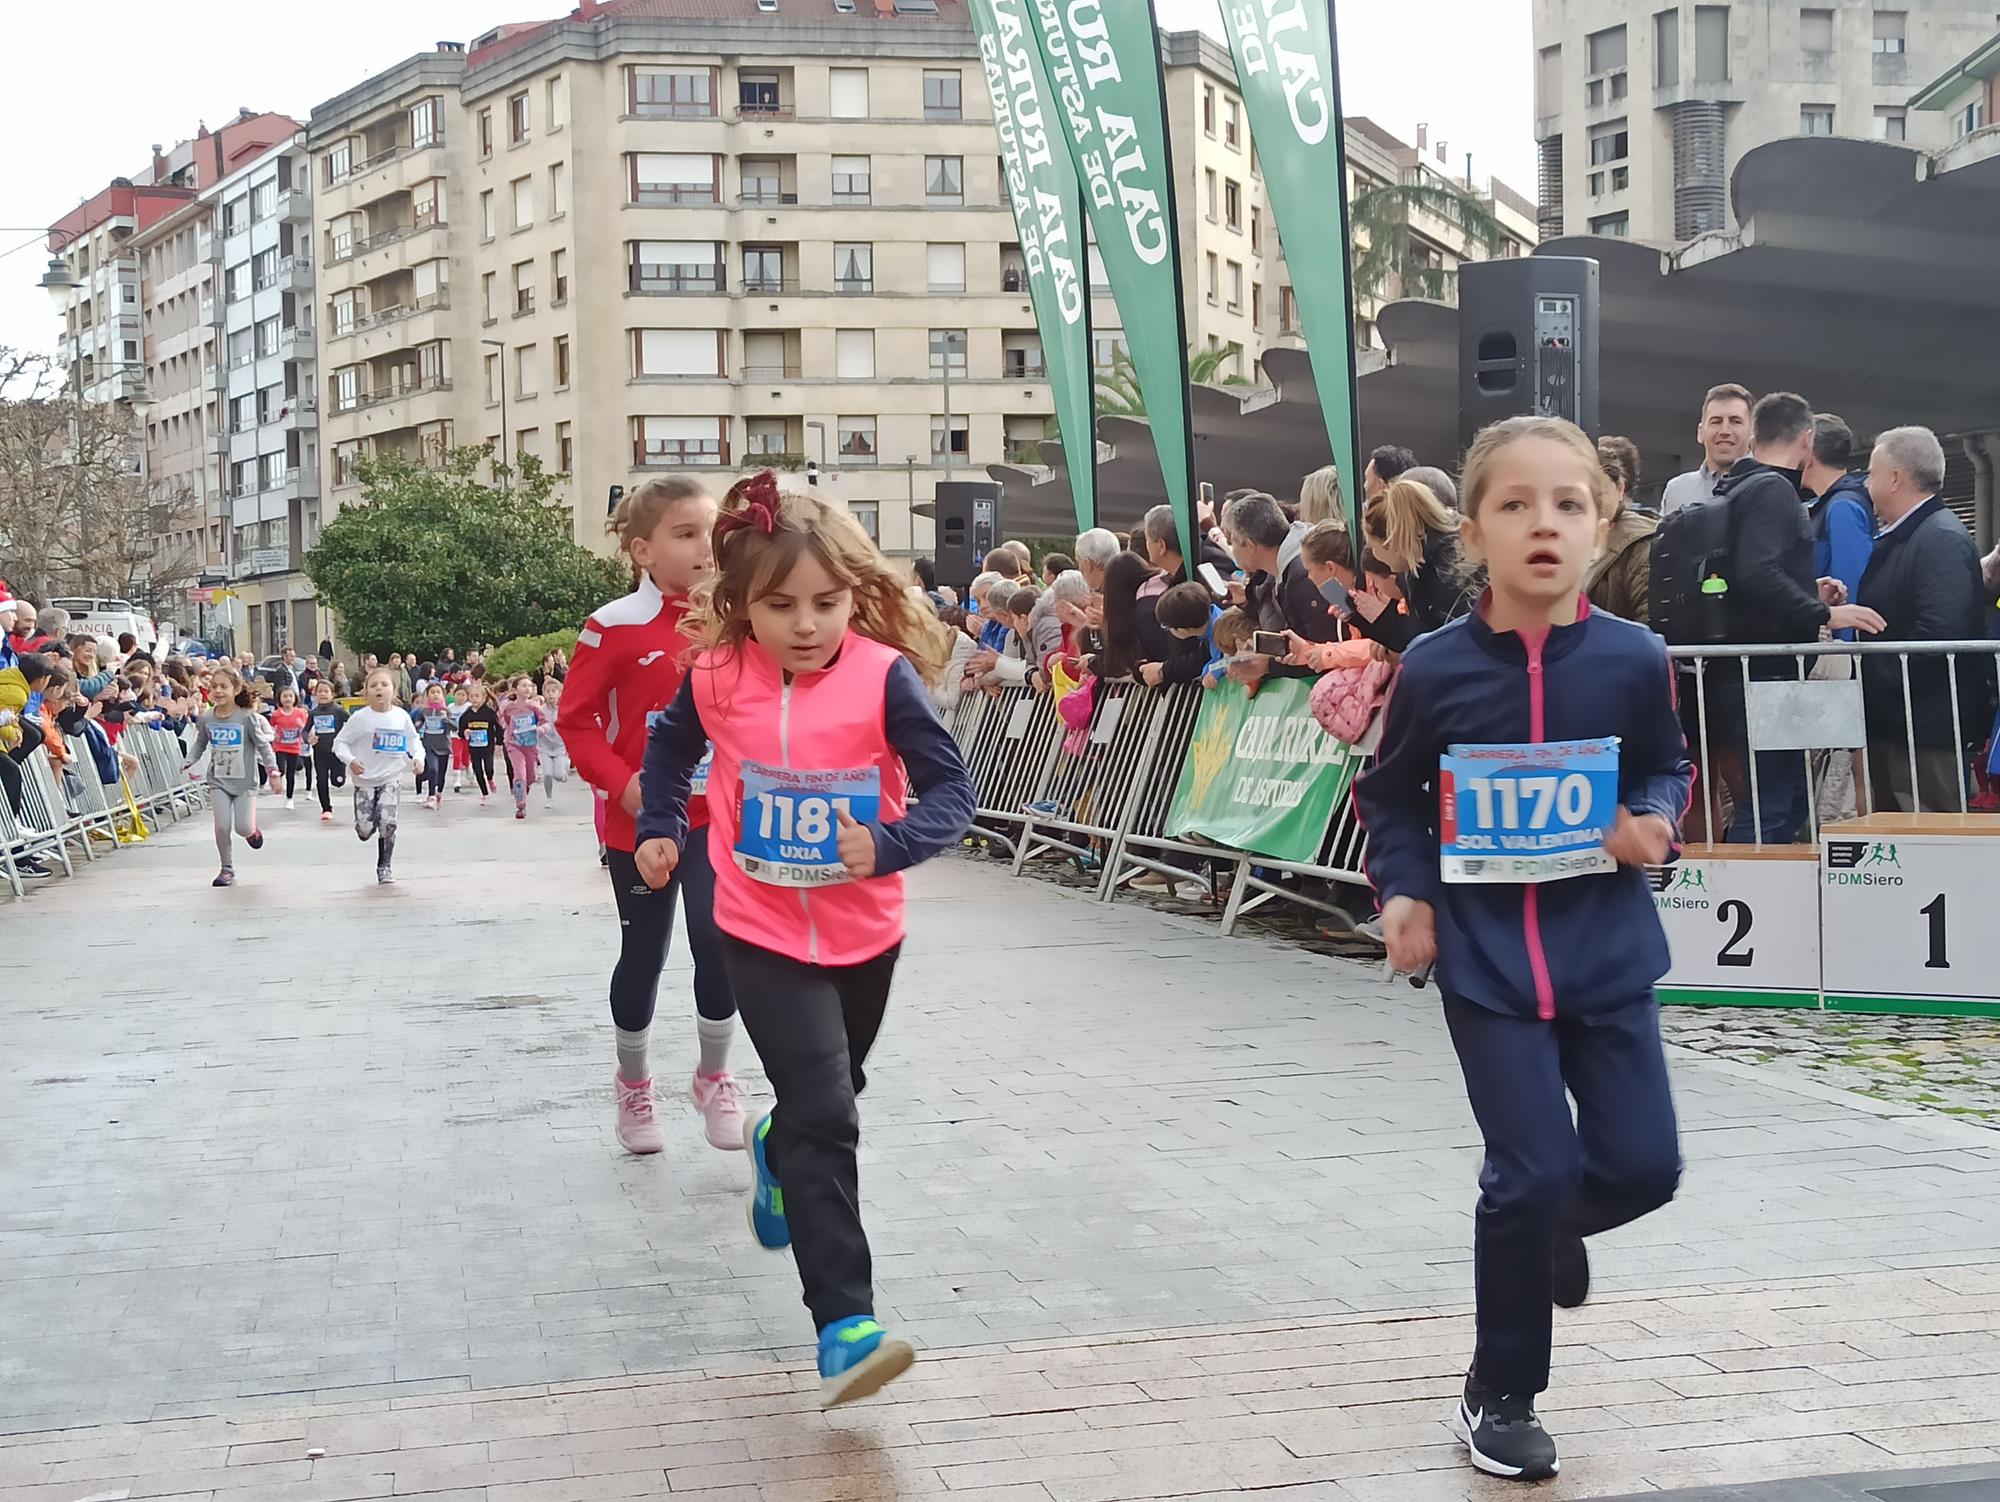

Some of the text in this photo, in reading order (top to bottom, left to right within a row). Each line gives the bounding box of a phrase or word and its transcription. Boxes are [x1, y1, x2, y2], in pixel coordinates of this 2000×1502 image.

[69, 623, 114, 634] LANCIA
[208, 728, 237, 741] 1220
[750, 764, 800, 783] CARRERA
[805, 773, 822, 783] FIN
[1469, 773, 1593, 830] 1170
[758, 792, 850, 844] 1181
[1455, 827, 1603, 850] SOL VALENTINA
[779, 844, 823, 861] UXIA
[1827, 872, 1904, 886] PDMSiero
[1716, 899, 1754, 967] 2
[1920, 893, 1951, 969] 1
